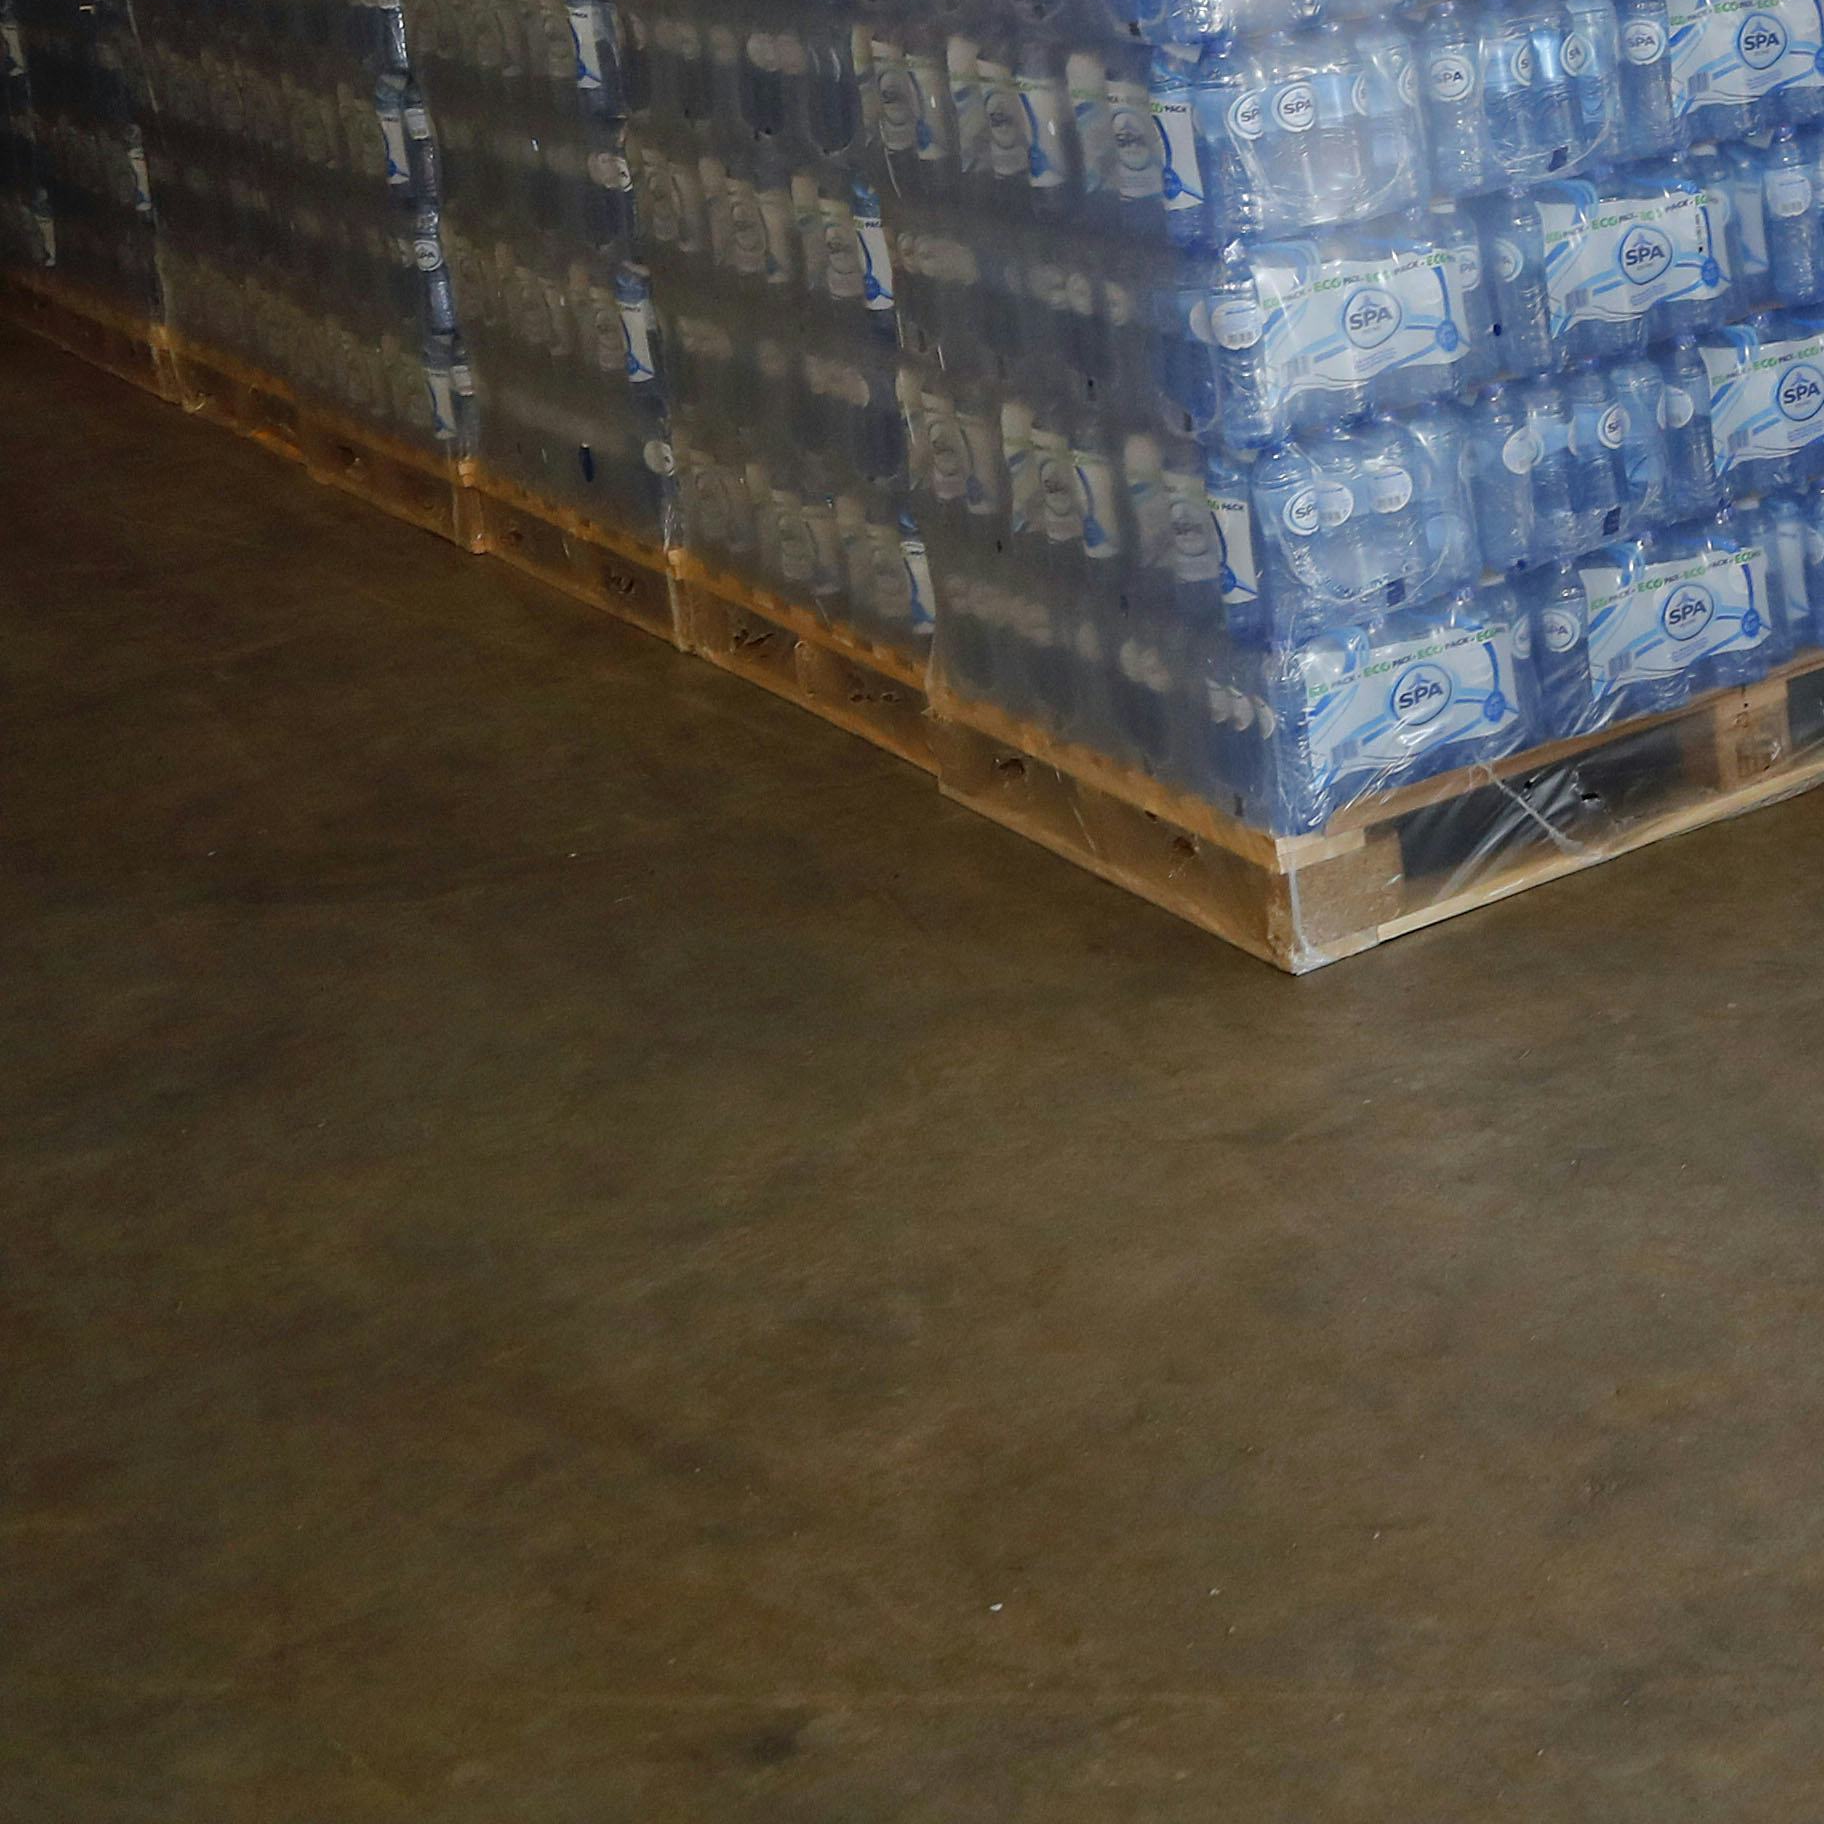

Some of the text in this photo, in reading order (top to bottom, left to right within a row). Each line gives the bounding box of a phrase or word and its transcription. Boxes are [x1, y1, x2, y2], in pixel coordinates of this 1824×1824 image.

[1743, 32, 1780, 51] SPA
[1625, 245, 1665, 266] SPA
[1350, 306, 1393, 330] SPA
[1784, 382, 1820, 404] SPA
[1669, 600, 1707, 625] SPA
[1400, 682, 1443, 710] SPA
